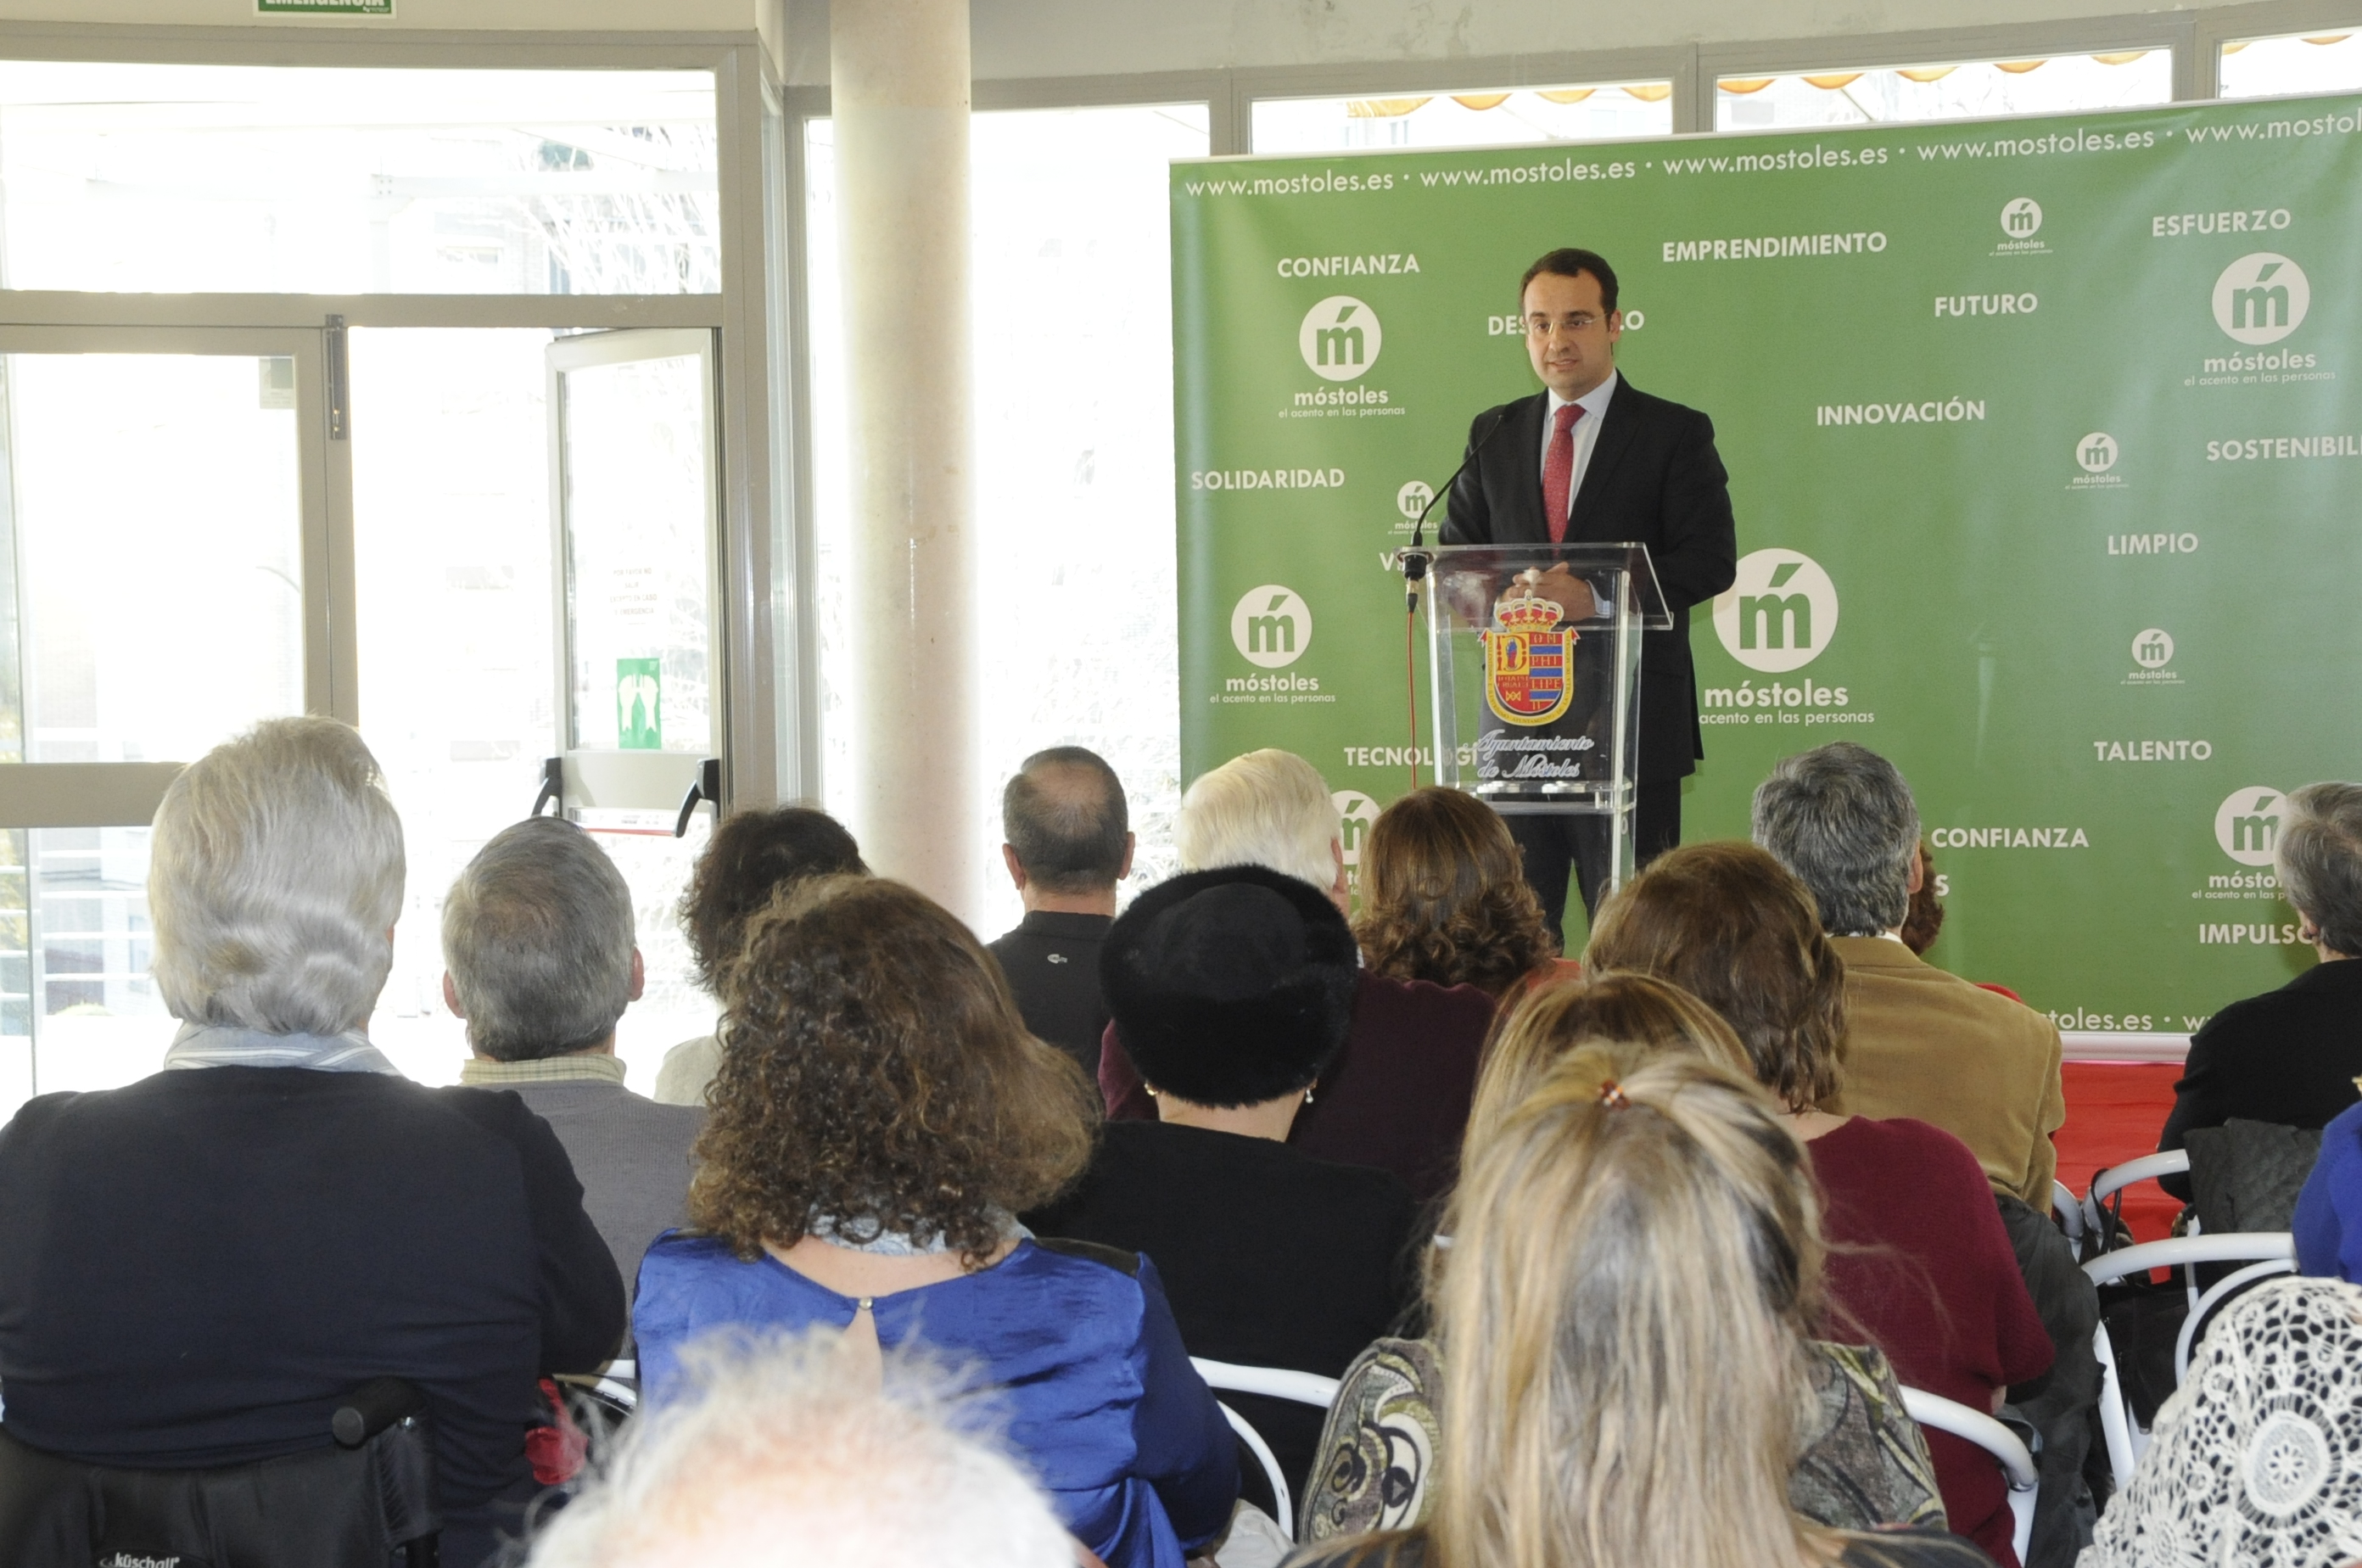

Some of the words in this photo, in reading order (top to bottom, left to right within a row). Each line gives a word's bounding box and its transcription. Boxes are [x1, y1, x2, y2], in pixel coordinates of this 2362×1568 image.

[1185, 168, 1394, 197] www.mostoles.es
[1419, 157, 1636, 188] www.mostoles.es
[1663, 143, 1889, 175] www.mostoles.es
[1917, 126, 2154, 160] www.mostoles.es
[2152, 209, 2291, 237] ESFUERZO
[1663, 232, 1888, 261] EMPRENDIMIENTO
[1997, 239, 2045, 250] móstoles
[1277, 255, 1419, 277] CONFIANZA
[1935, 293, 2037, 317] FUTURO
[2204, 348, 2316, 373] móstoles
[2184, 375, 2195, 386] el
[2199, 374, 2239, 385] acento
[2261, 372, 2278, 383] las
[2282, 371, 2336, 384] personas
[1295, 384, 1389, 406] móstoles
[1279, 408, 1288, 418] el
[1290, 407, 1324, 417] acento
[1342, 406, 1357, 417] las
[1360, 407, 1406, 418] personas
[1817, 396, 1985, 426] INNOVACIÓN
[2206, 435, 2362, 461] SOSTENIBIL
[1191, 468, 1345, 490] SOLIDARIDAD
[2107, 532, 2198, 555] LIMPIO
[1226, 671, 1319, 692] móstoles
[1209, 693, 1219, 703] el
[1222, 694, 1256, 703] acento
[1259, 695, 1271, 703] en
[1273, 692, 1288, 703] las
[1290, 694, 1336, 705] personas
[1704, 678, 1849, 708] móstoles
[1699, 712, 1749, 725] acento
[1755, 714, 1773, 724] en
[1778, 709, 1799, 724] las
[1805, 712, 1875, 727] personas
[1465, 729, 1595, 761] Ayuntamiento
[2093, 740, 2212, 761] TALENTO
[1931, 827, 2090, 848] CONFIANZA
[2191, 889, 2202, 899] el
[2204, 890, 2241, 899] acento
[2259, 889, 2275, 899] las
